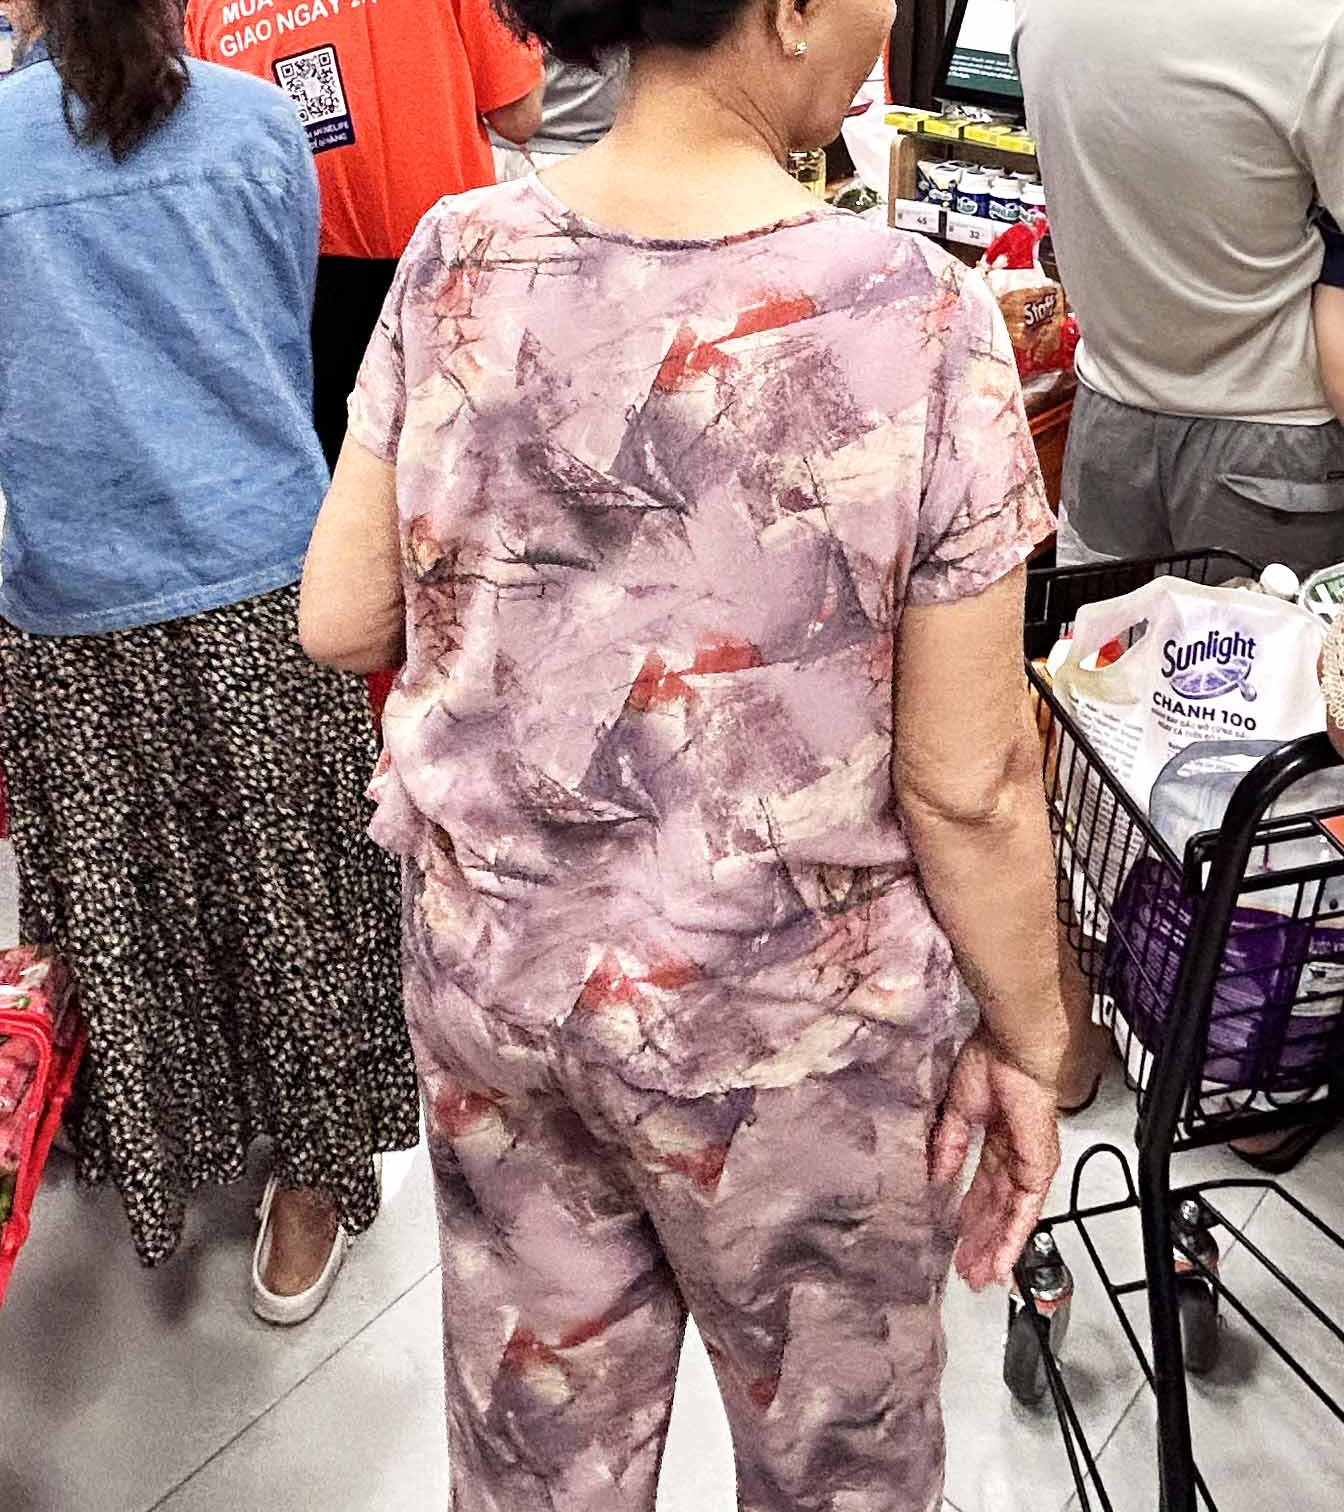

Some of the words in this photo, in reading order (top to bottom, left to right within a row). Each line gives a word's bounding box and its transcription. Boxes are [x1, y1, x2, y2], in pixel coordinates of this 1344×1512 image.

[219, 18, 273, 58] GIAO
[1161, 630, 1256, 678] Sunlight
[1153, 691, 1215, 721] CHANH
[1221, 710, 1257, 731] 100
